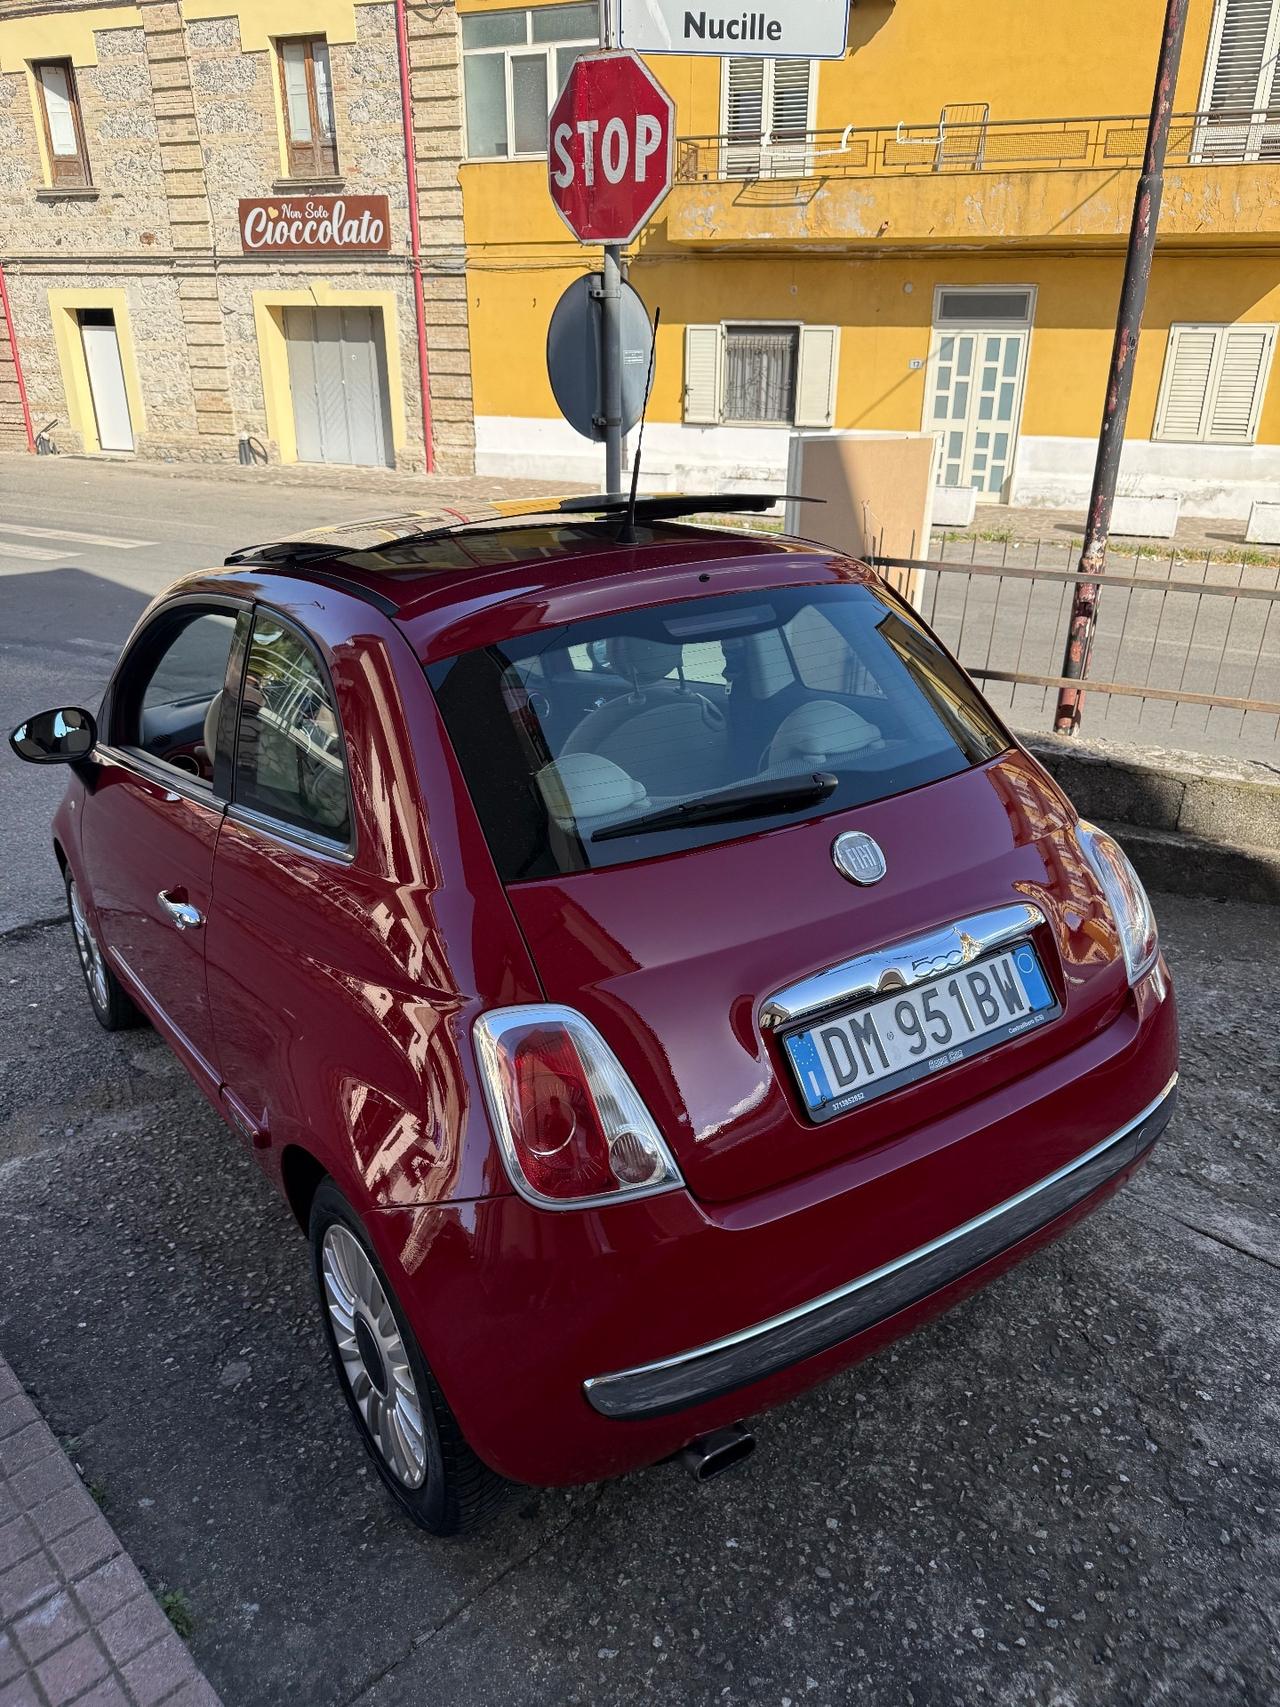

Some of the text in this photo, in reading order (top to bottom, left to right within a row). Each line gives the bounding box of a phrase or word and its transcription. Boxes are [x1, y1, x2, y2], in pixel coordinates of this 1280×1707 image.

[684, 11, 782, 41] Nucille
[554, 114, 662, 189] STOP
[244, 200, 384, 248] Cioccolato
[281, 201, 329, 219] Non Solo
[845, 843, 877, 872] FIAT
[912, 949, 963, 977] 500
